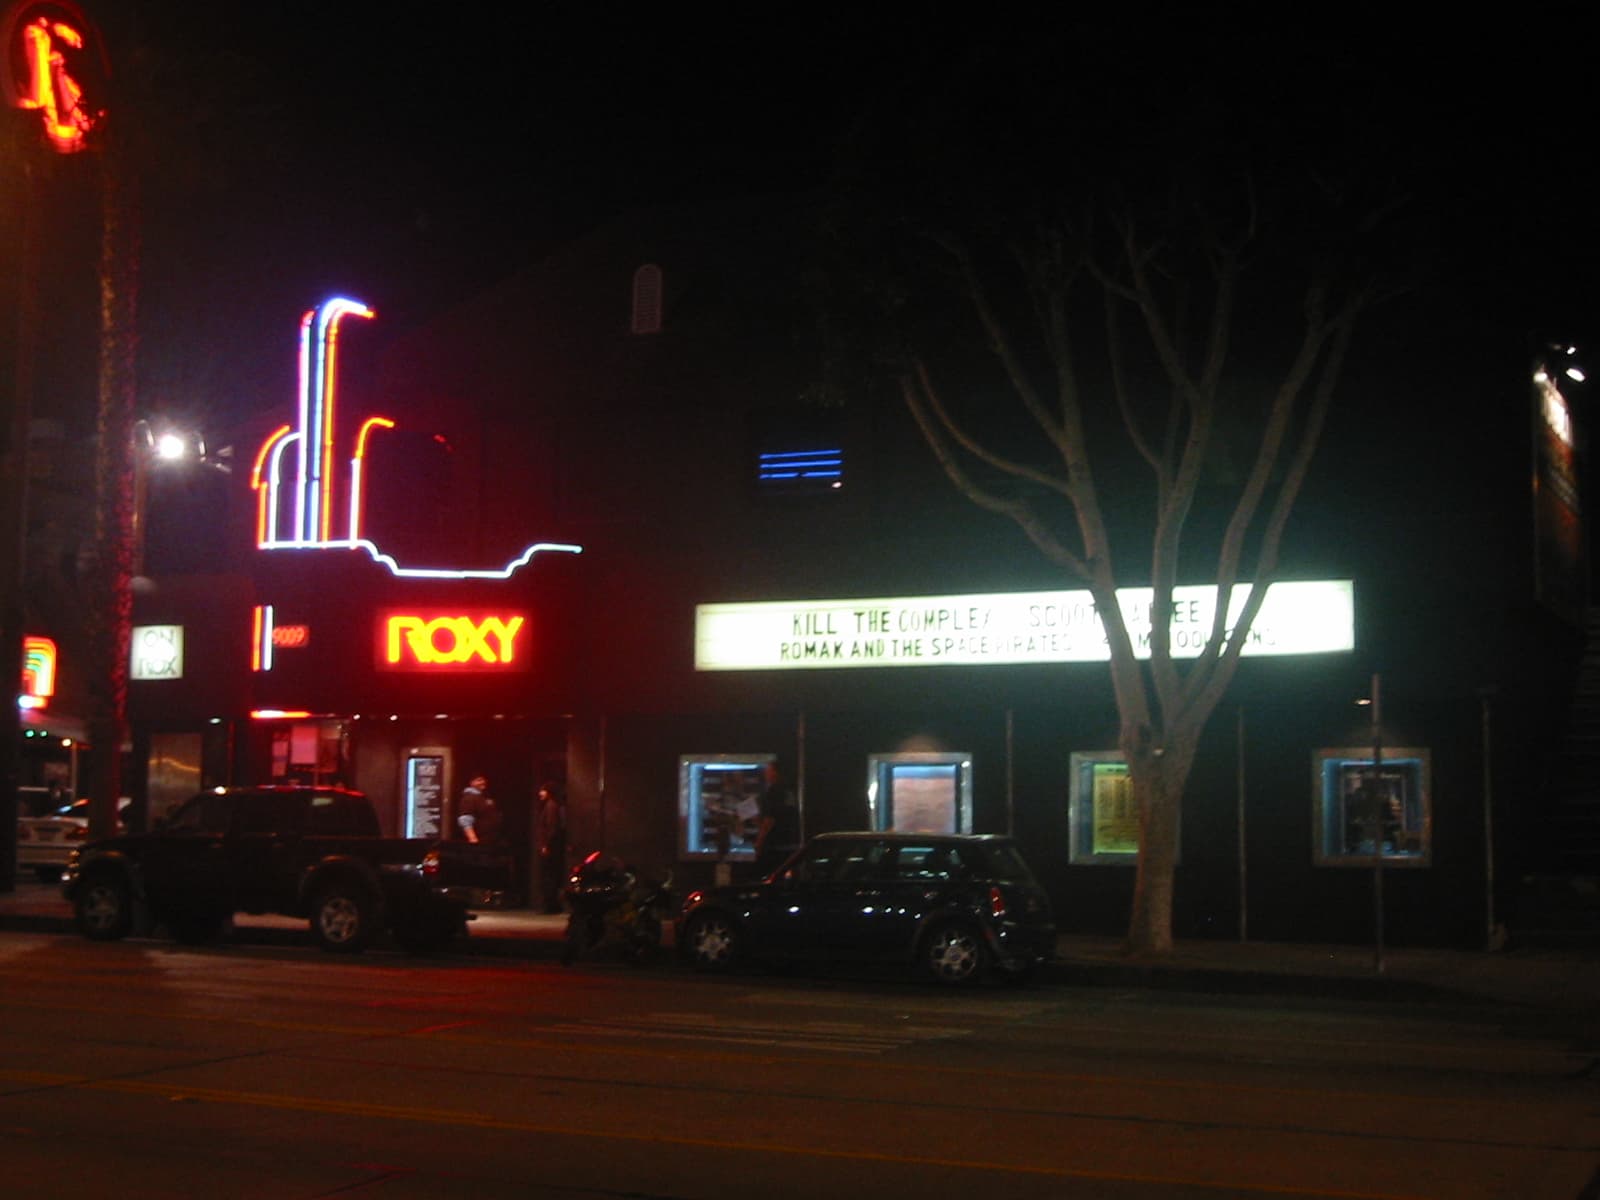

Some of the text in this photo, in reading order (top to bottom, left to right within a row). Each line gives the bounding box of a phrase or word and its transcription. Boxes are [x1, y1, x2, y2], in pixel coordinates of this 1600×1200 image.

[793, 611, 837, 636] KILL
[853, 610, 891, 634] THE
[143, 628, 175, 648] ON
[387, 615, 525, 664] ROXY
[780, 640, 843, 661] ROMAK
[850, 638, 885, 659] AND
[892, 637, 923, 657] THE
[931, 635, 988, 656] SPACE
